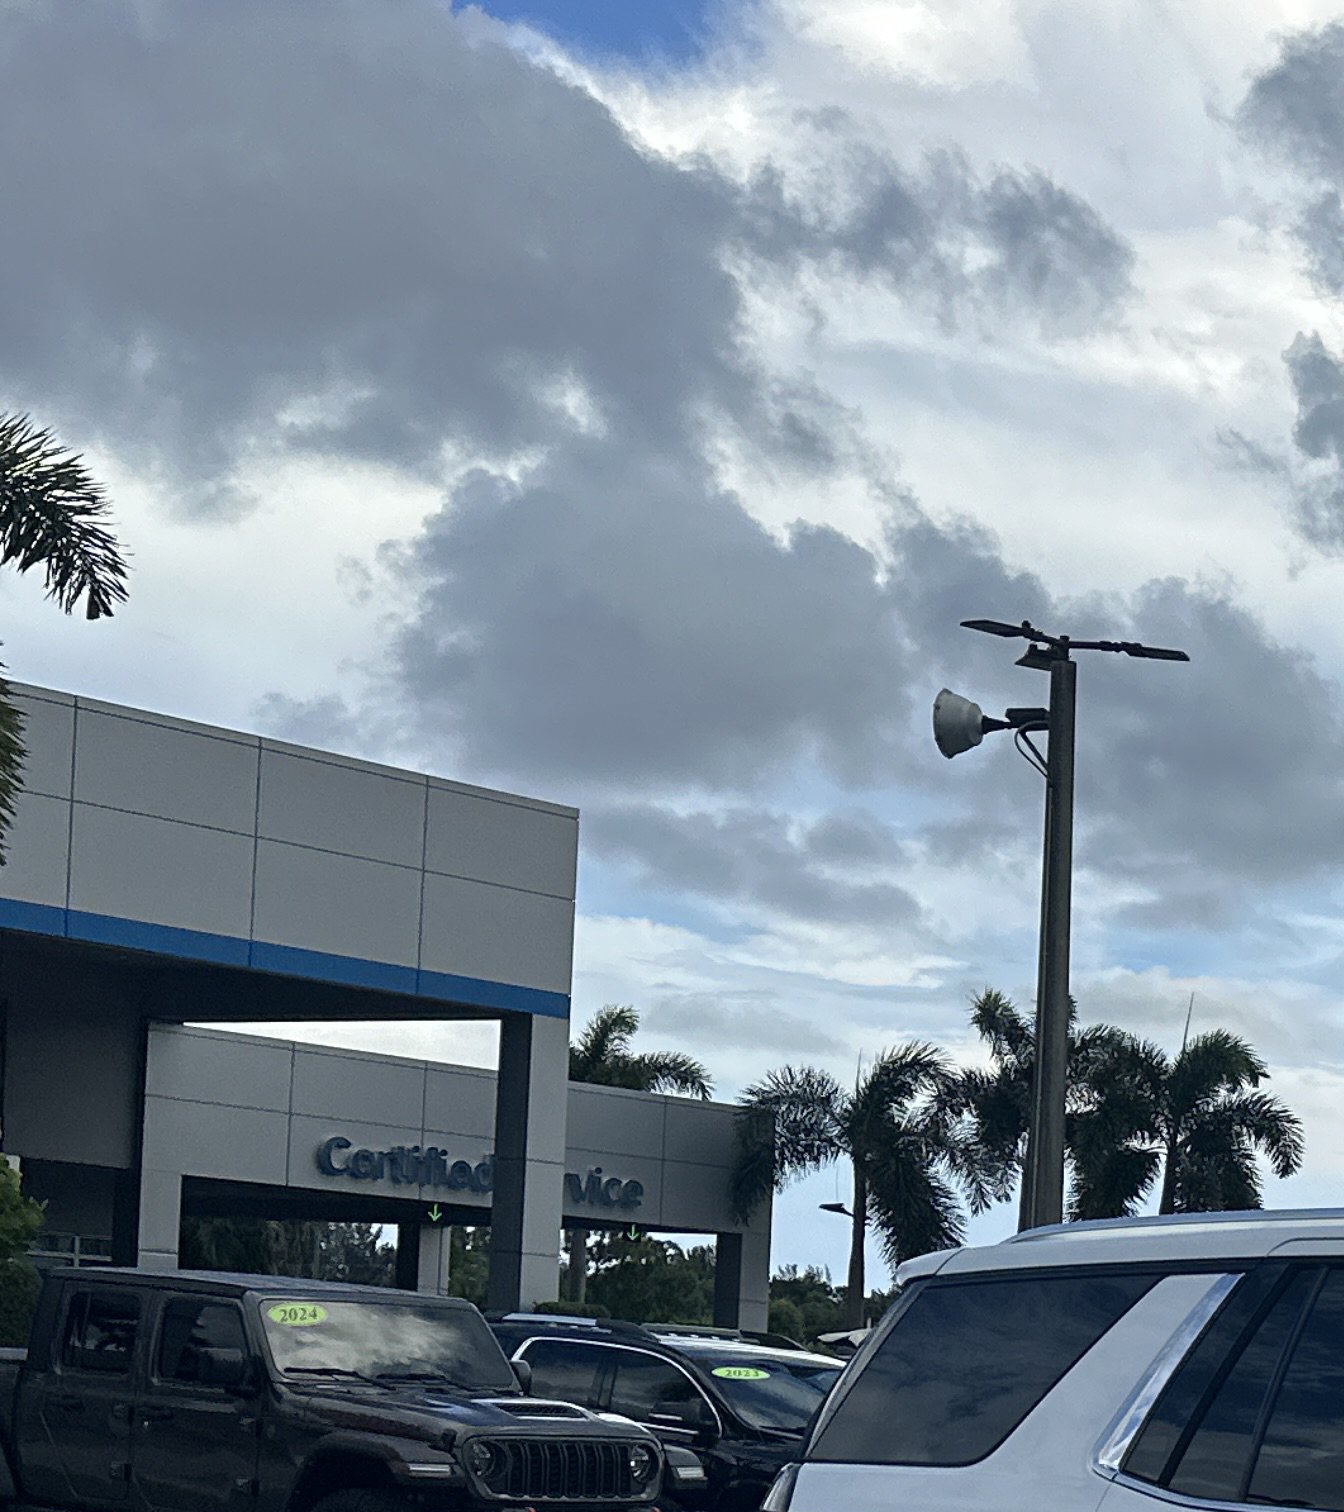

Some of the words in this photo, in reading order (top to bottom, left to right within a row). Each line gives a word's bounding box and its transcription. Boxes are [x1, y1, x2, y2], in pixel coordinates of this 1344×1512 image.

[318, 1136, 495, 1193] Certified
[563, 1167, 645, 1207] vice
[279, 1307, 317, 1322] 2024
